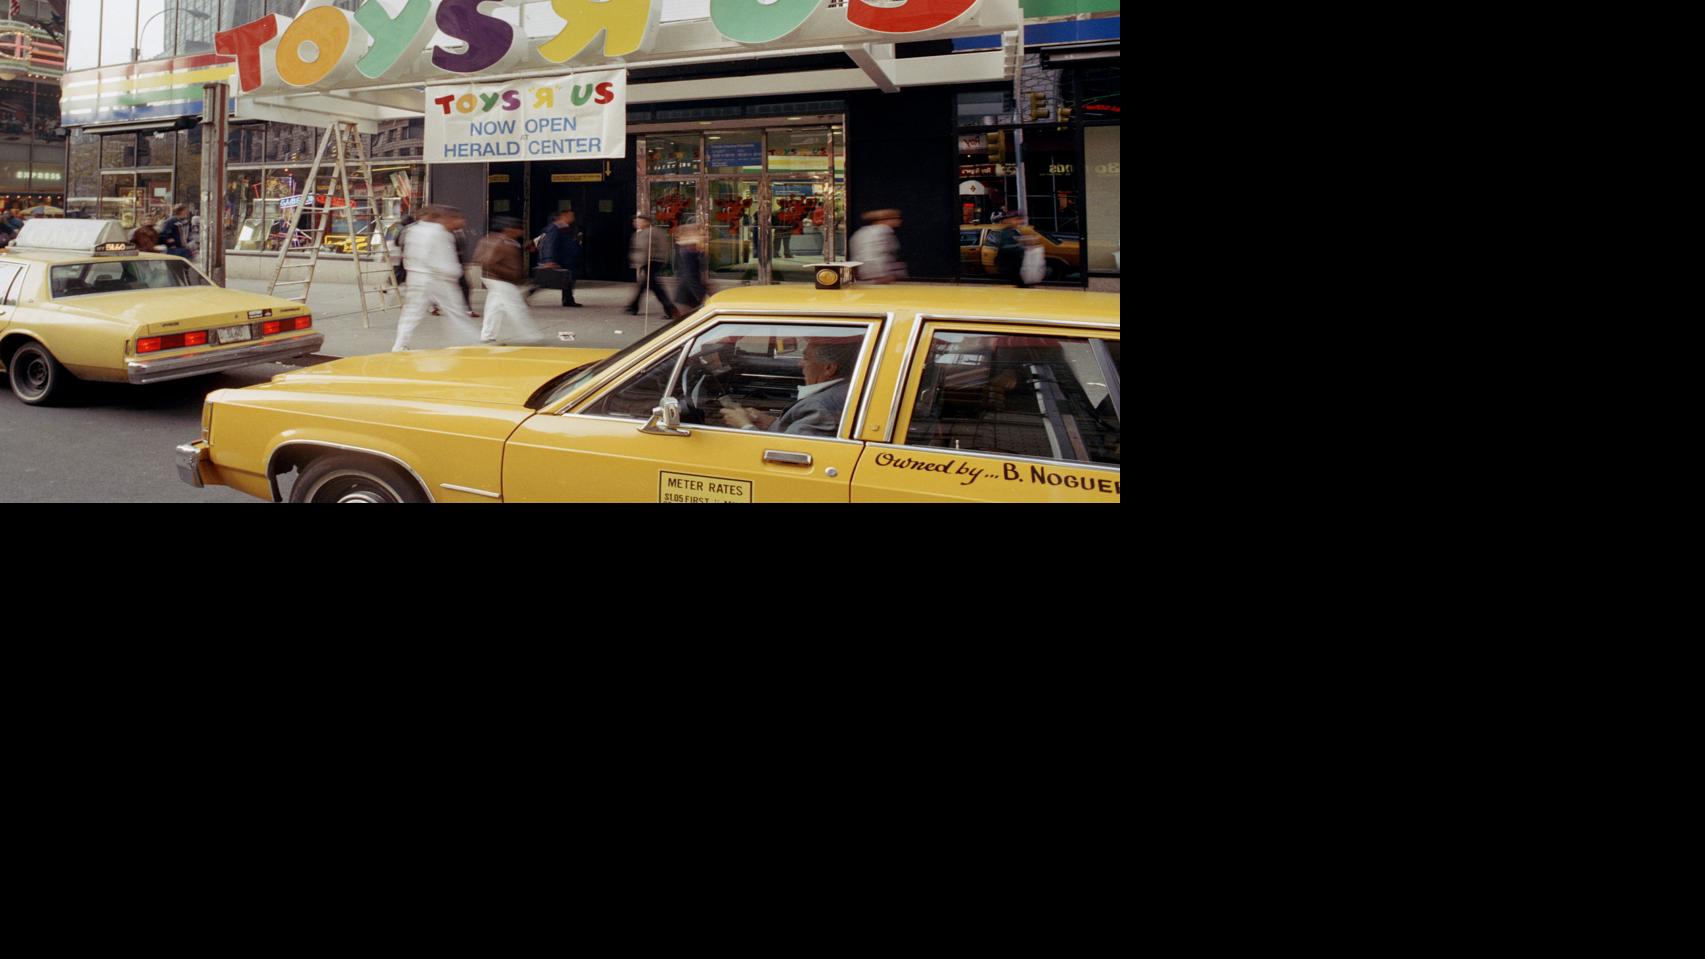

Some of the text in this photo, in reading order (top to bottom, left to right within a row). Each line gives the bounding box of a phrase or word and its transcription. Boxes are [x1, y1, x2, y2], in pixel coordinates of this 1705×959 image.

[214, 0, 515, 93] TOYS
[434, 90, 521, 115] TOYS
[570, 82, 615, 106] US
[470, 116, 577, 136] NOW OPEN
[444, 137, 602, 158] HERALD CENTER
[875, 452, 955, 474] Owned
[1003, 462, 1023, 482] B.
[667, 478, 743, 496] METER RATES
